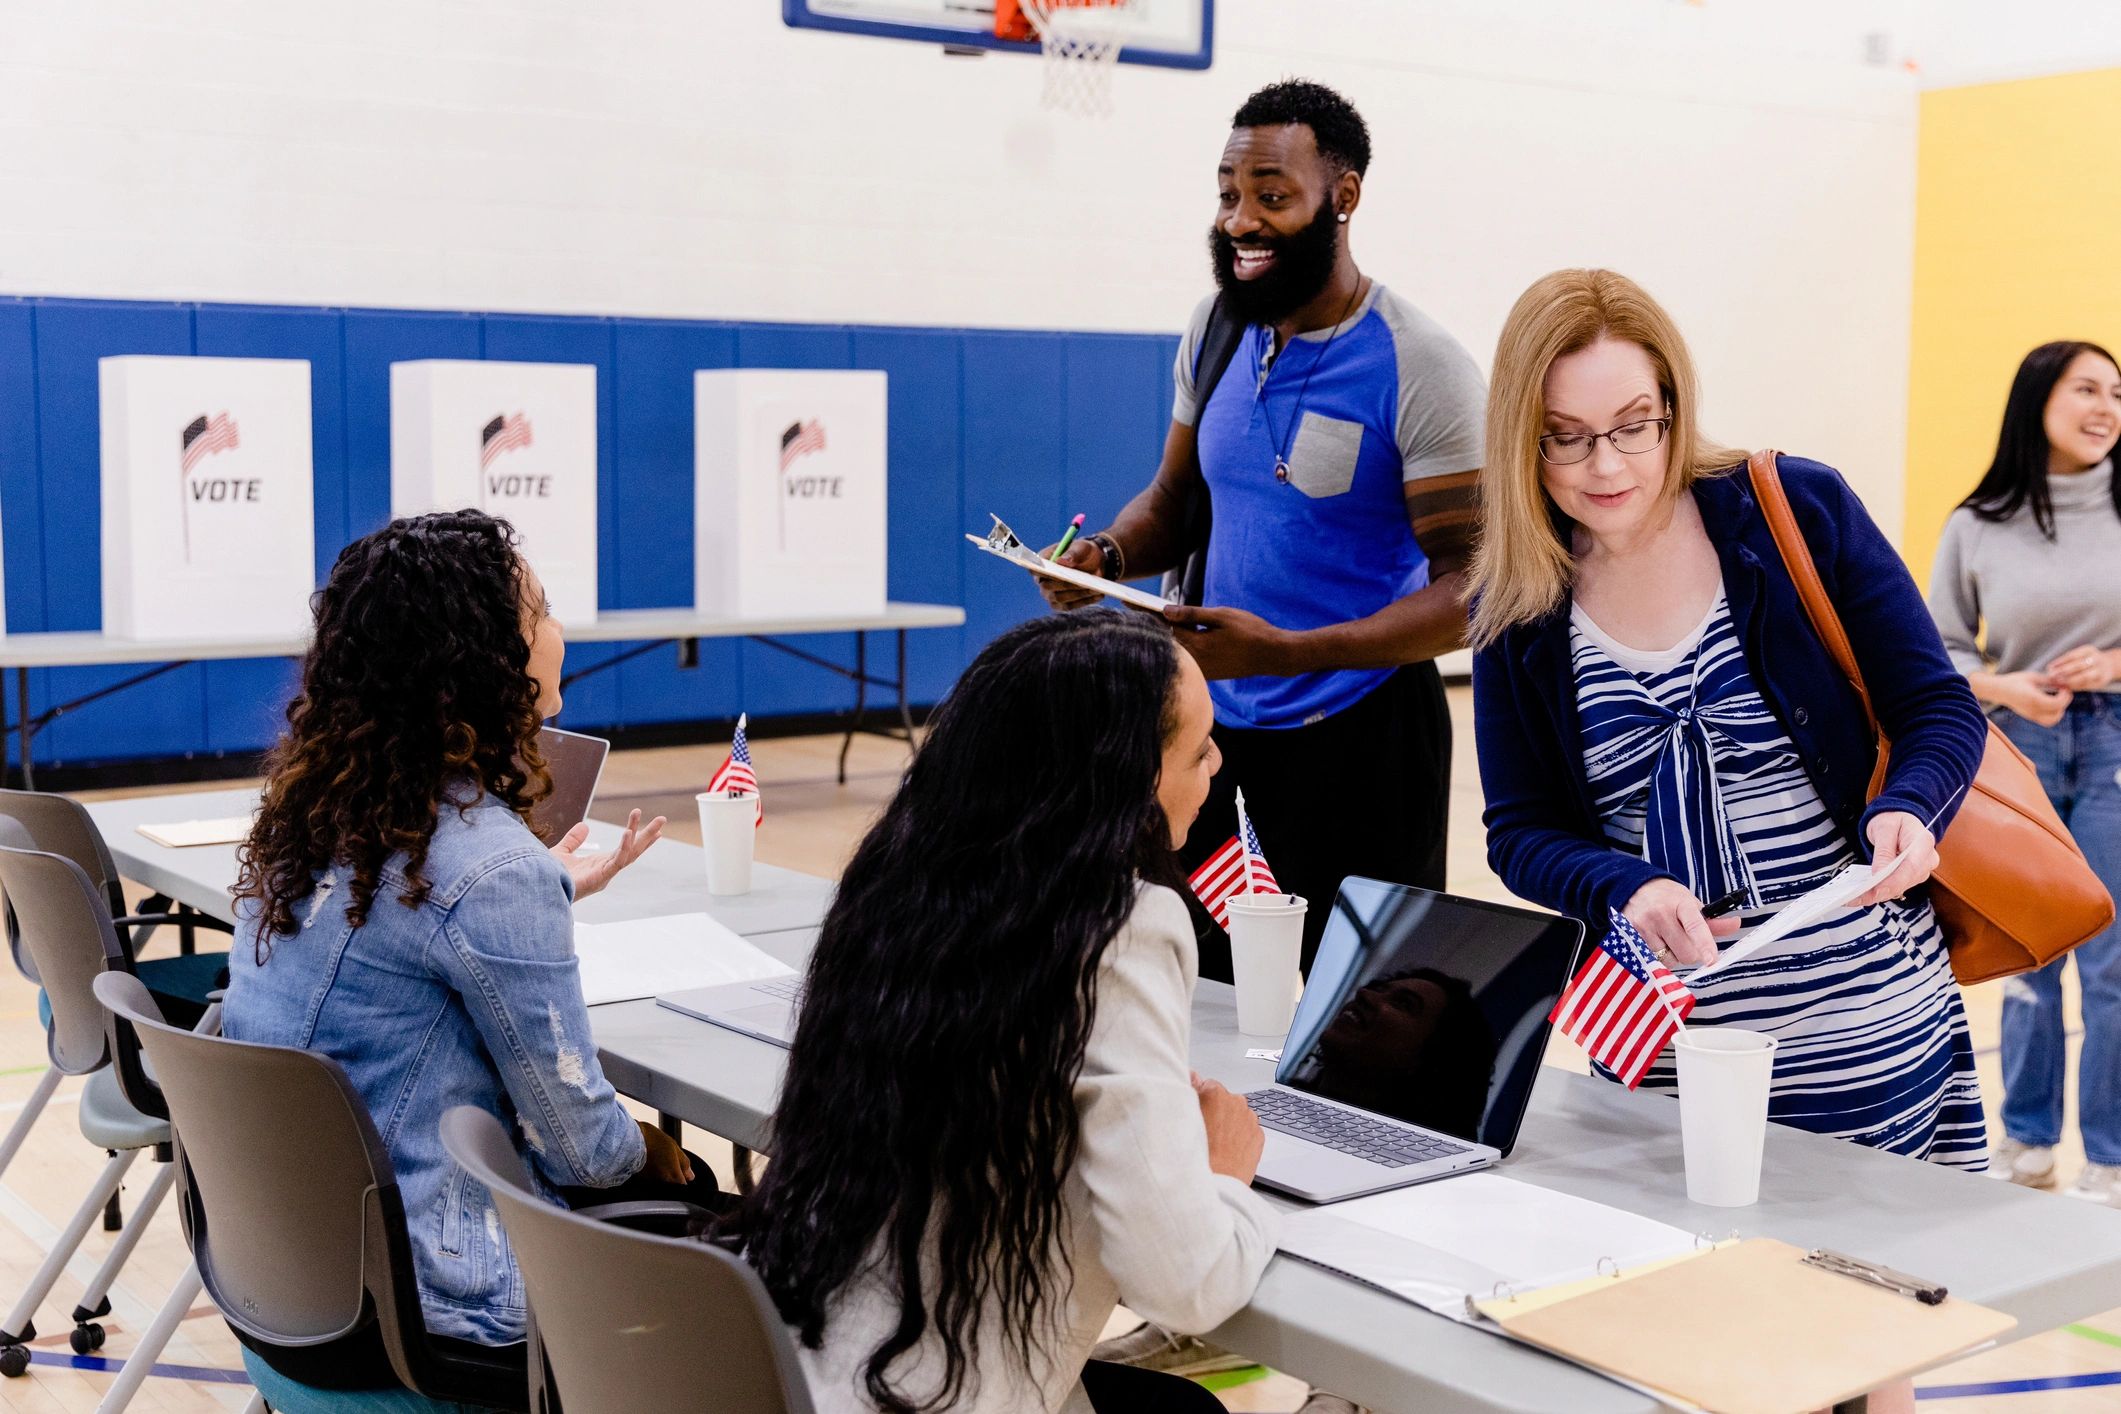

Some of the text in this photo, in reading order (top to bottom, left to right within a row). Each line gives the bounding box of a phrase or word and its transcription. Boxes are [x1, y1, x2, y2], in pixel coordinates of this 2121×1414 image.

[192, 479, 262, 502] VOTE
[489, 475, 552, 497] VOTE
[787, 477, 844, 498] VOTE
